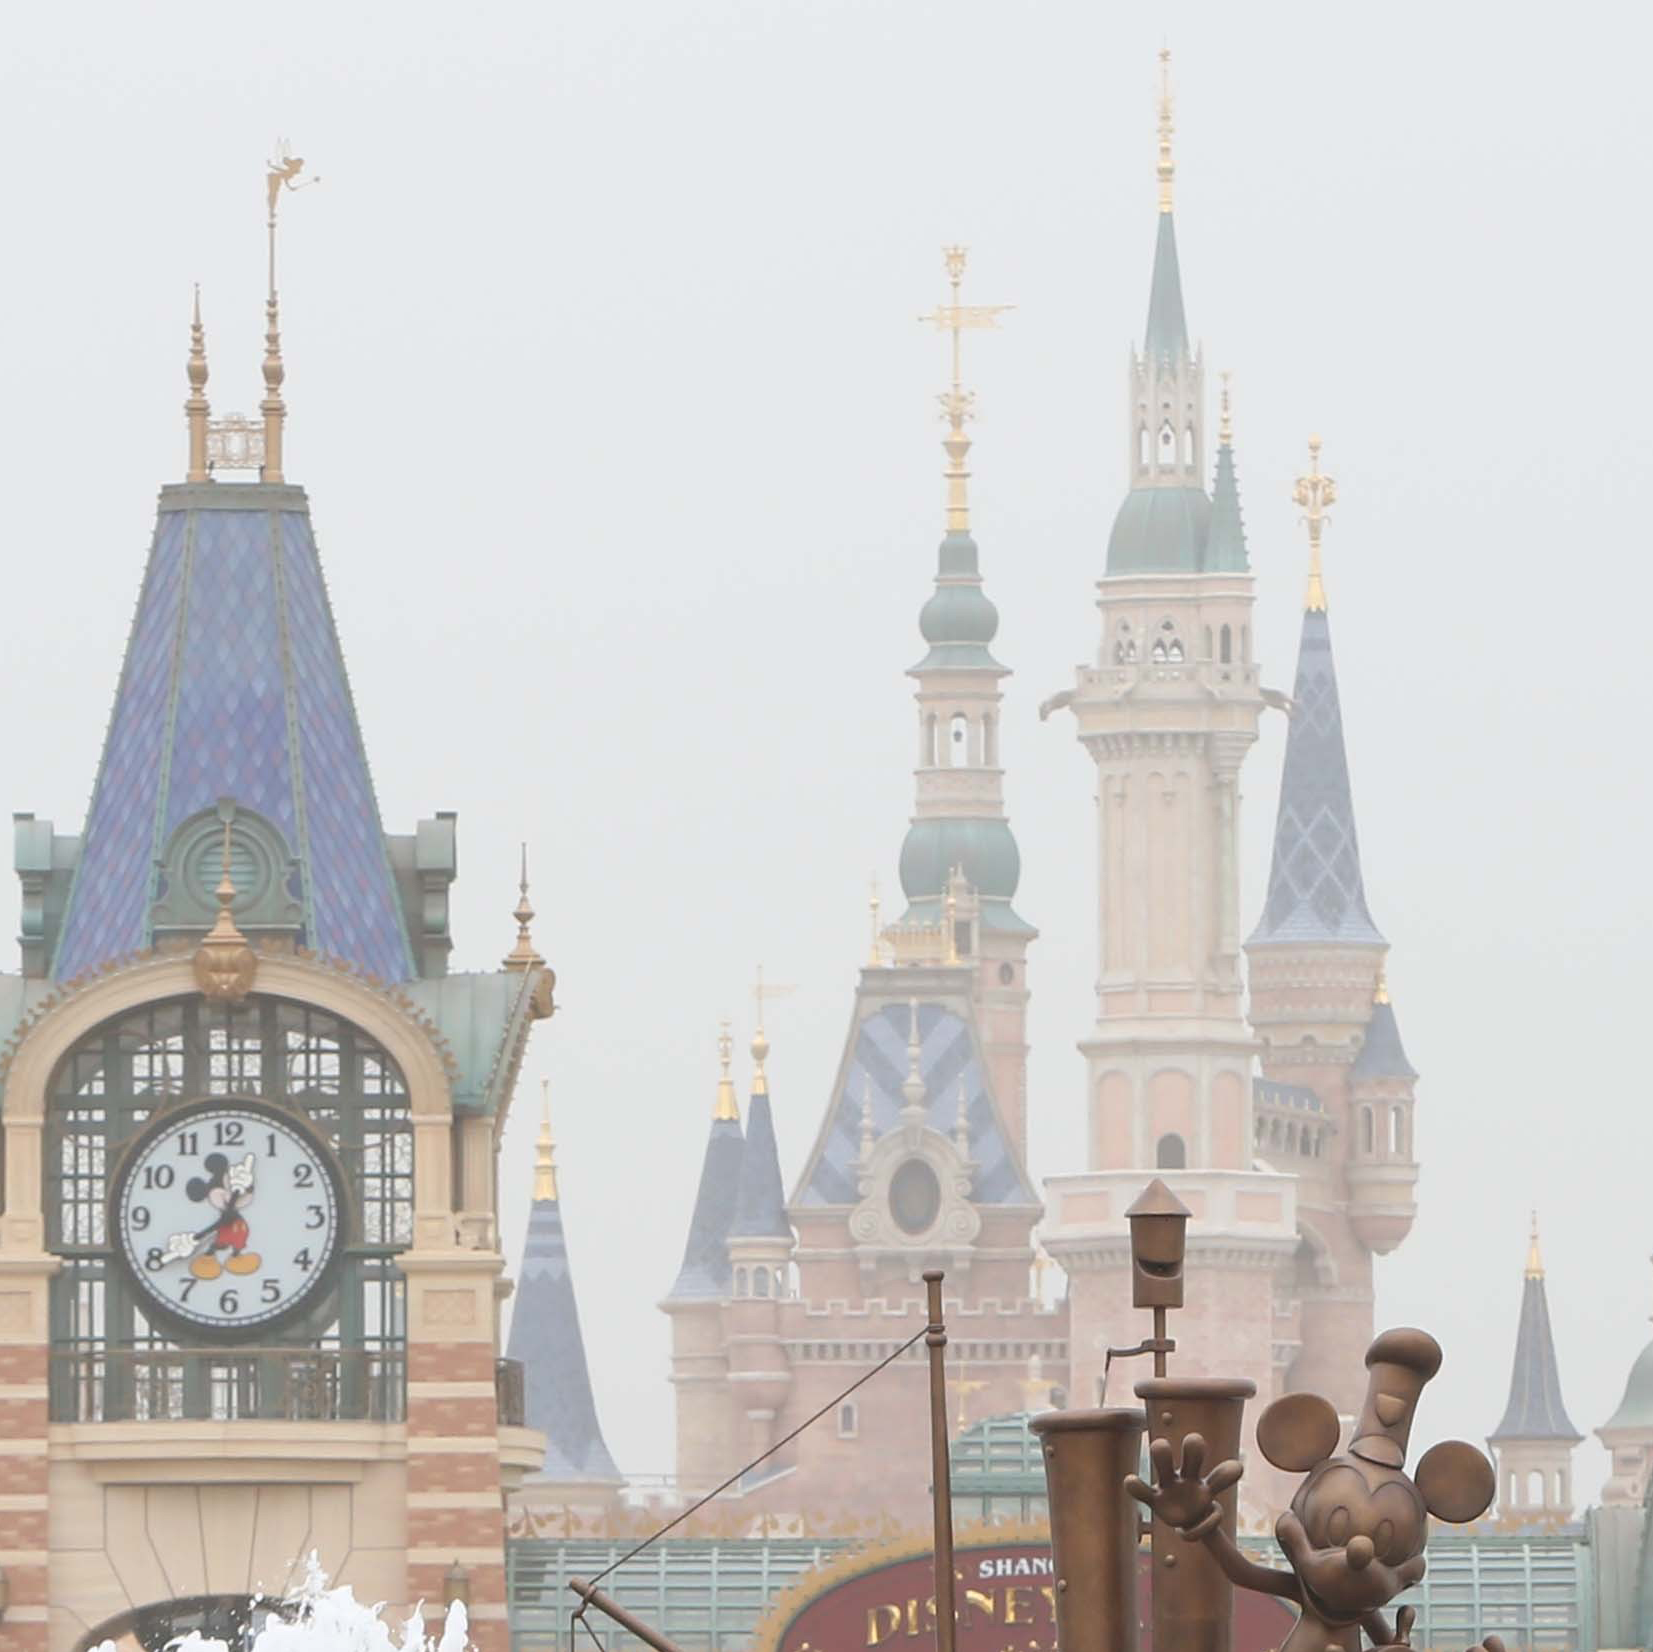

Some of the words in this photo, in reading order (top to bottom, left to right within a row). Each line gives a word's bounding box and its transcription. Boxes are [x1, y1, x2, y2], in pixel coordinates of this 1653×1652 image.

[177, 1132, 198, 1156] 11
[214, 1121, 245, 1146] 12
[266, 1133, 278, 1157] 1
[143, 1164, 175, 1189] 10
[293, 1164, 314, 1188] 2
[131, 1206, 151, 1231] 9
[305, 1205, 326, 1229] 3
[144, 1248, 165, 1272] 8
[293, 1249, 313, 1272] 4
[179, 1278, 197, 1302] 7
[219, 1289, 239, 1314] 6
[260, 1279, 281, 1303] 5
[979, 1557, 1054, 1579] SHAN
